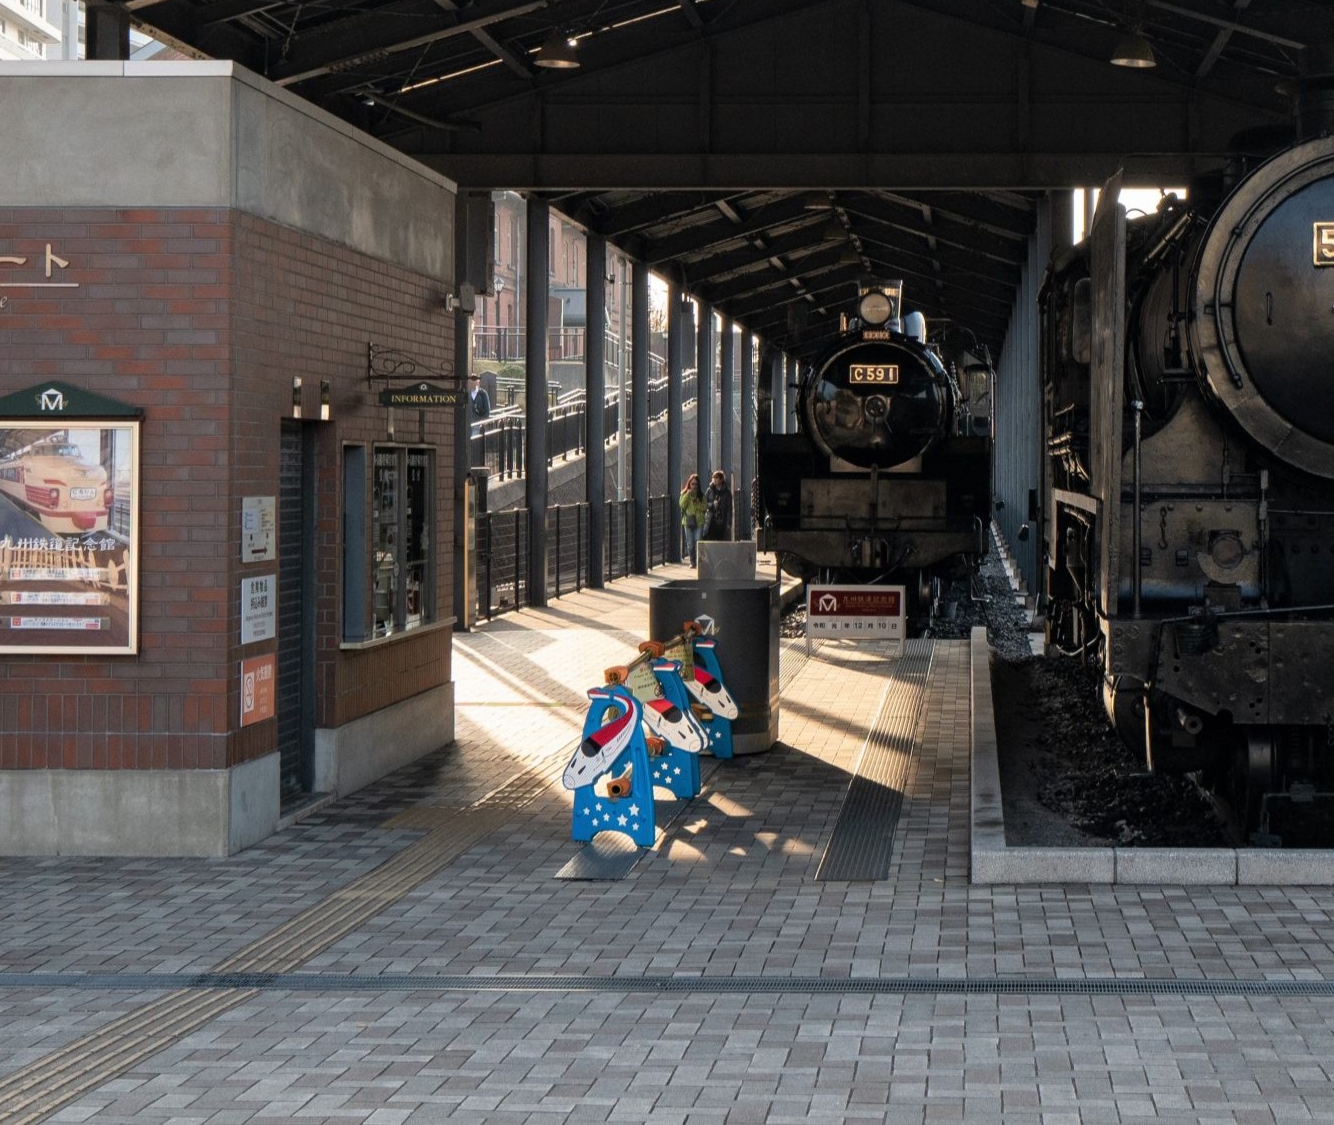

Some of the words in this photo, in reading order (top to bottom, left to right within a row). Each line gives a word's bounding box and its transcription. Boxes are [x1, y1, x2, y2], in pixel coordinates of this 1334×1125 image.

[391, 394, 457, 404] INFORMATION
[0, 536, 116, 552] 九州鉄道記念館
